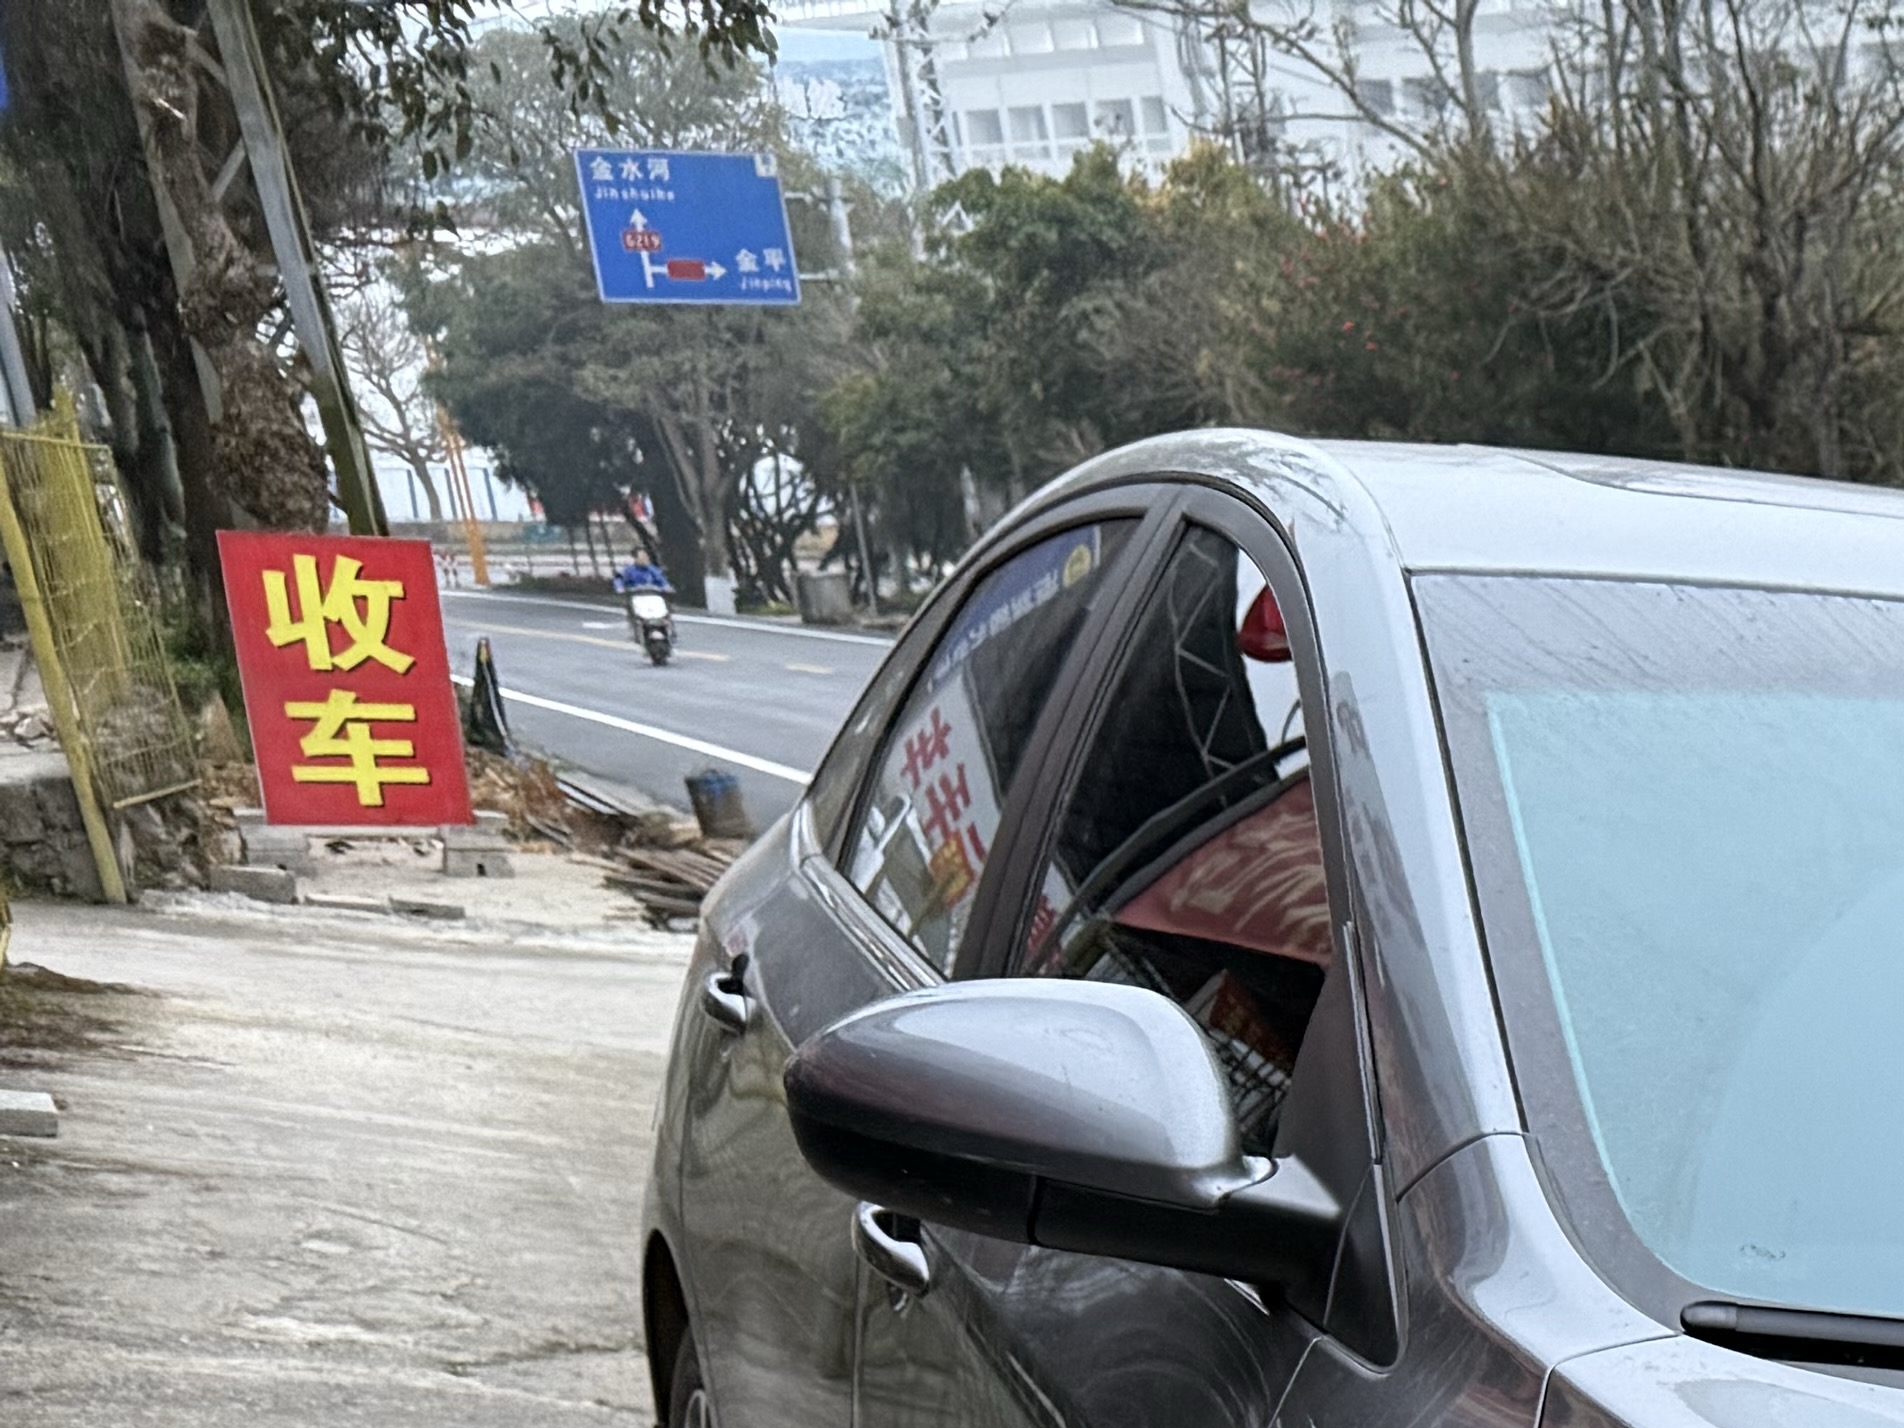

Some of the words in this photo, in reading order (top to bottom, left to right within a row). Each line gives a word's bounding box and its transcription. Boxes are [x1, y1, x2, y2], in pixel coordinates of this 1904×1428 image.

[589, 155, 671, 182] 金水河
[262, 554, 431, 806] 收车
